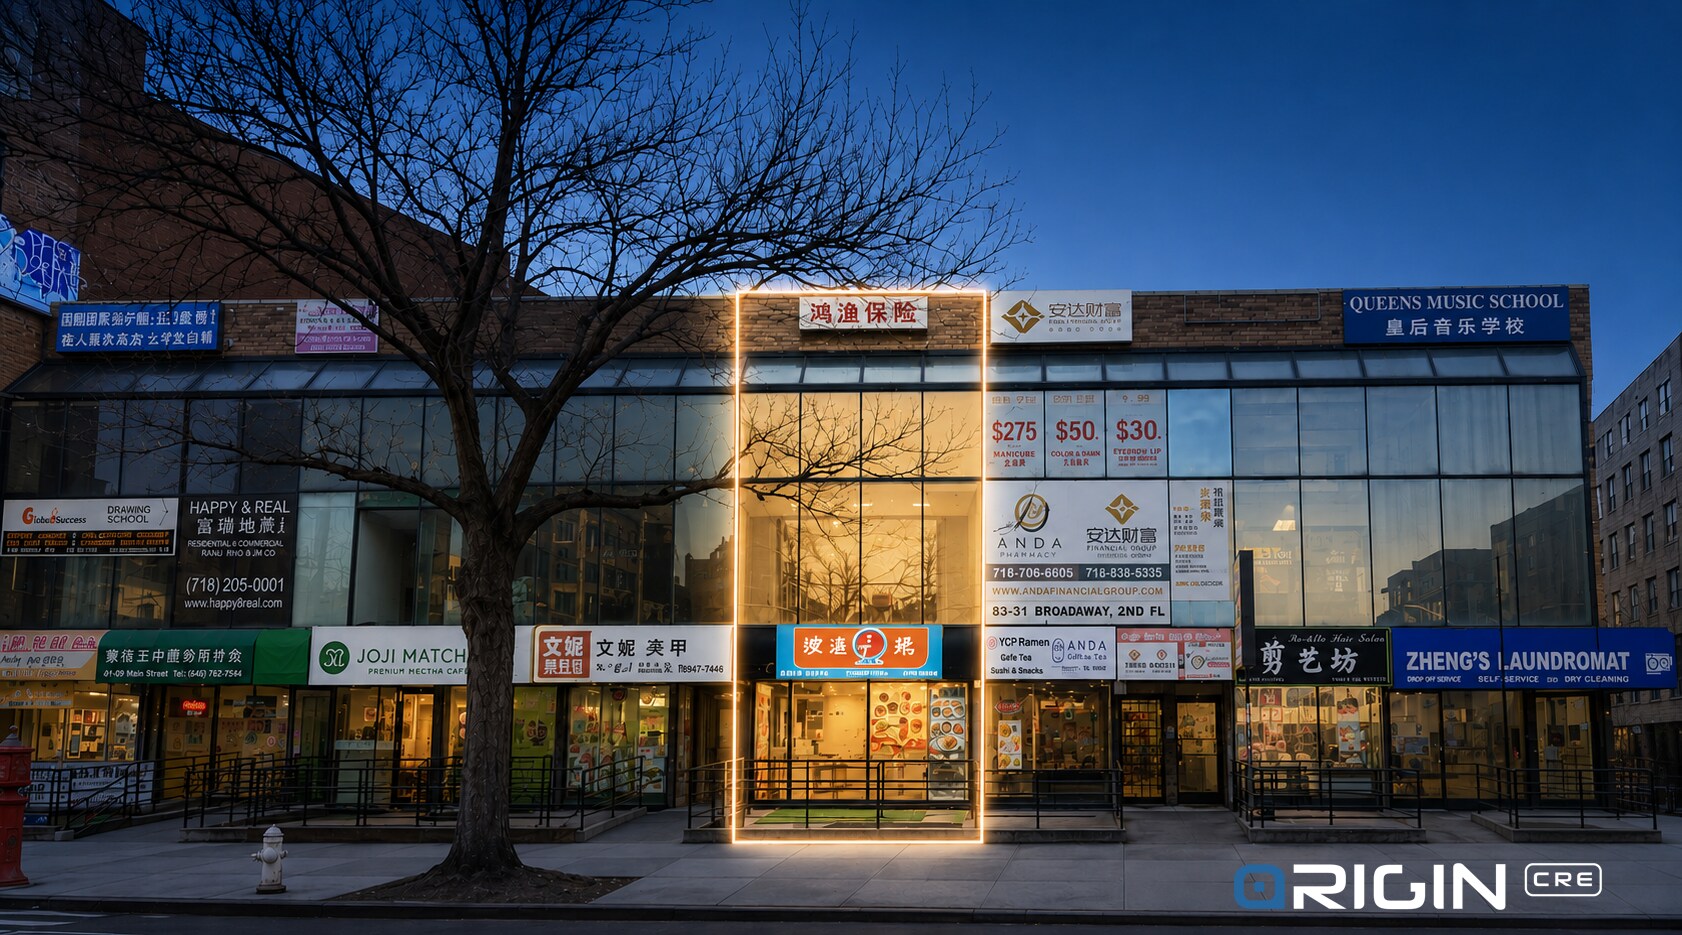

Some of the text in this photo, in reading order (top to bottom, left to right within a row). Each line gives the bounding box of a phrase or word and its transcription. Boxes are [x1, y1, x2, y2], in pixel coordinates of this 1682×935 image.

[1049, 303, 1122, 317] 安达财富
[1350, 293, 1564, 313] QUEENS MUSIC SCHOOL
[811, 301, 917, 323] 鸿渔保险
[1385, 317, 1525, 336] 皇后音乐学校
[992, 419, 1037, 443] $275
[107, 505, 151, 514] DRAWING
[190, 500, 290, 514] HAPPY & REAL
[56, 516, 87, 525] Success
[107, 514, 149, 524] SCHOOL
[1086, 527, 1157, 544] 安达财富
[998, 537, 1062, 549] ANDA
[993, 567, 1074, 578] 718-706-6605
[1086, 567, 1162, 578] 718-838-5335
[186, 577, 285, 595] (718) 205-0001
[992, 587, 1163, 596] WWW.ANDAFINANCIALGROUP.COM
[992, 606, 1165, 618] 83-31 BROADAWAY, 2ND FL
[543, 636, 584, 657] 文妮
[596, 639, 635, 657] 文妮
[999, 638, 1050, 647] YCP Ramen
[1067, 640, 1107, 651] ANDA
[357, 649, 466, 663] JOJI MATCH
[1260, 640, 1359, 675] 剪艺坊
[1406, 651, 1630, 670] ZHENG'S LAUNDROMAT
[1565, 675, 1581, 683] DRY
[1584, 675, 1629, 683] CLEANING
